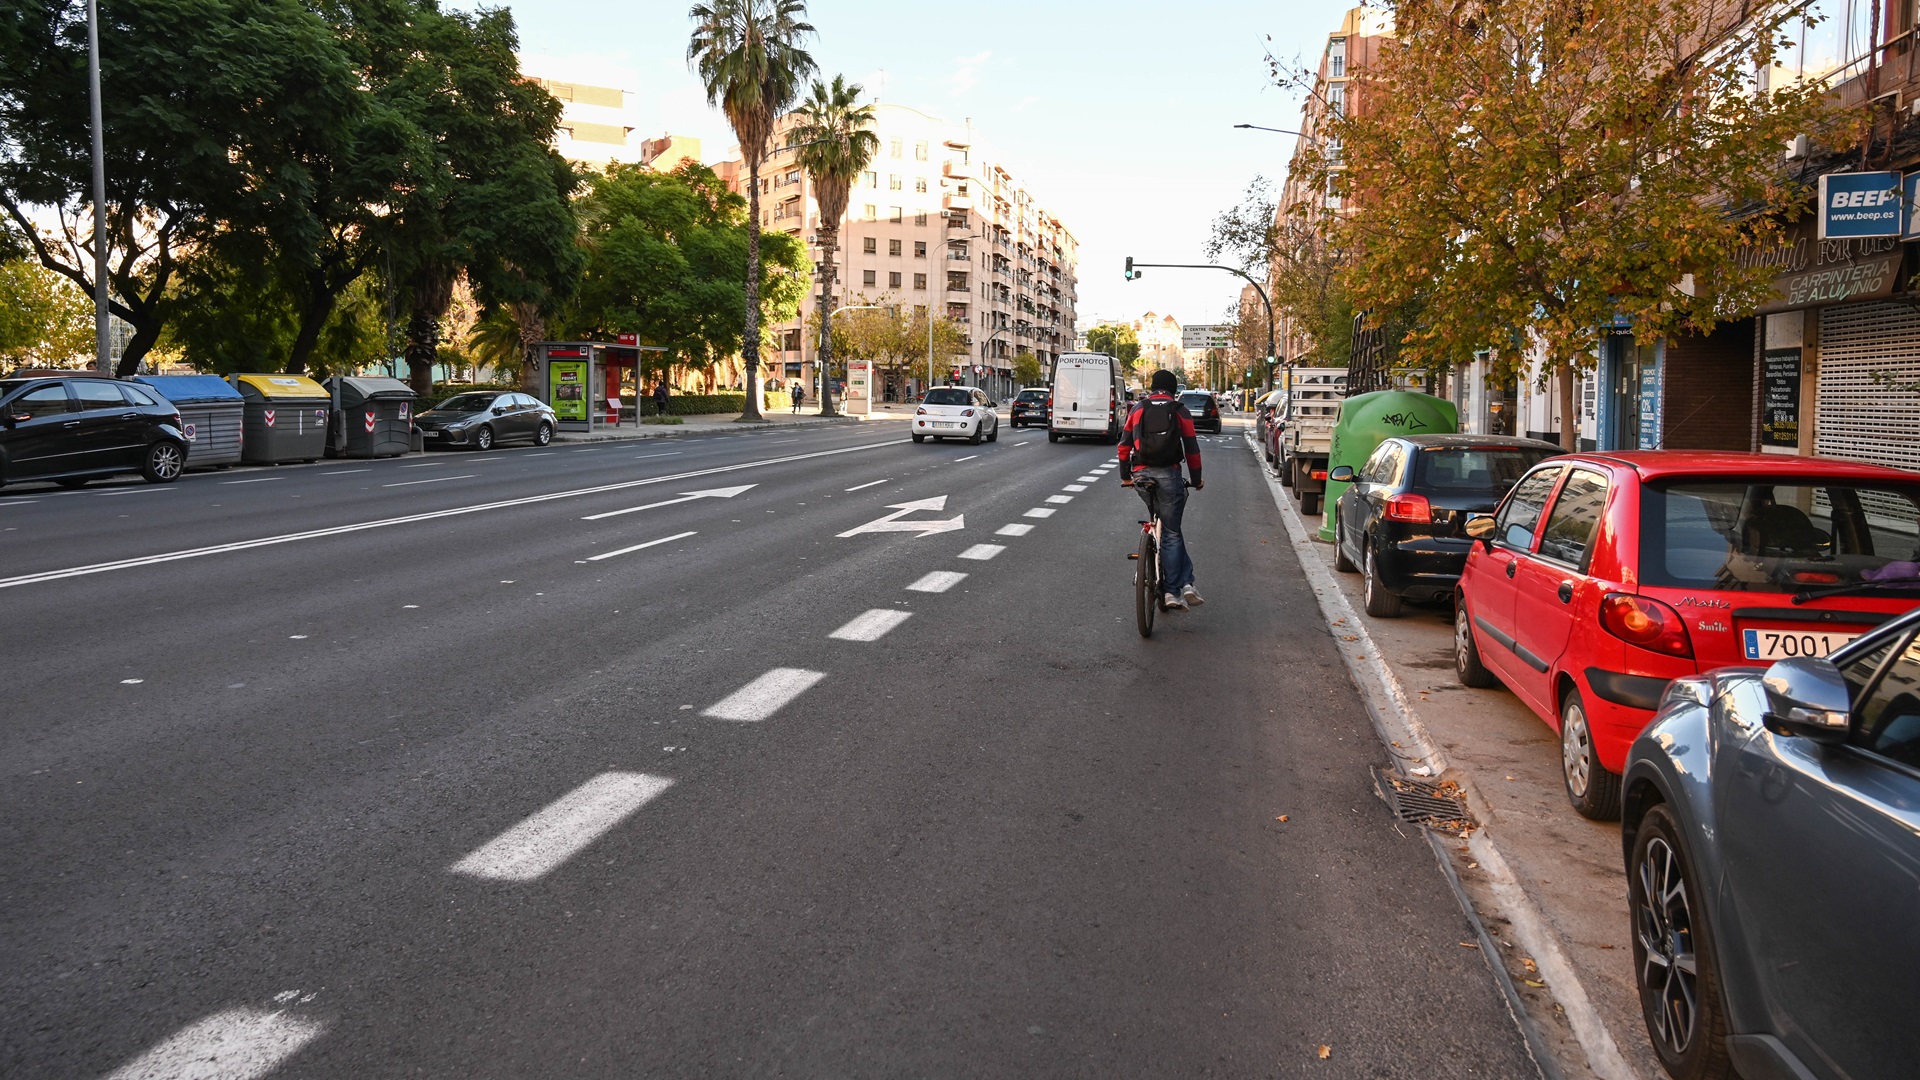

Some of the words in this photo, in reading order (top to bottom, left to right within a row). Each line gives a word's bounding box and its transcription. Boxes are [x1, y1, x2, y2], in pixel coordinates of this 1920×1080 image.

[1831, 190, 1895, 208] BEEP
[1831, 212, 1895, 221] www.beep.es
[1790, 260, 1890, 291] CARPINTERIA
[1788, 289, 1805, 306] DE
[1807, 278, 1883, 301] ALUMINIO
[1059, 357, 1108, 366] PORTAMOTOS
[1601, 370, 1604, 382] DE
[1642, 399, 1650, 412] 0%
[1698, 621, 1727, 633] Smile
[1765, 634, 1830, 656] 7001
